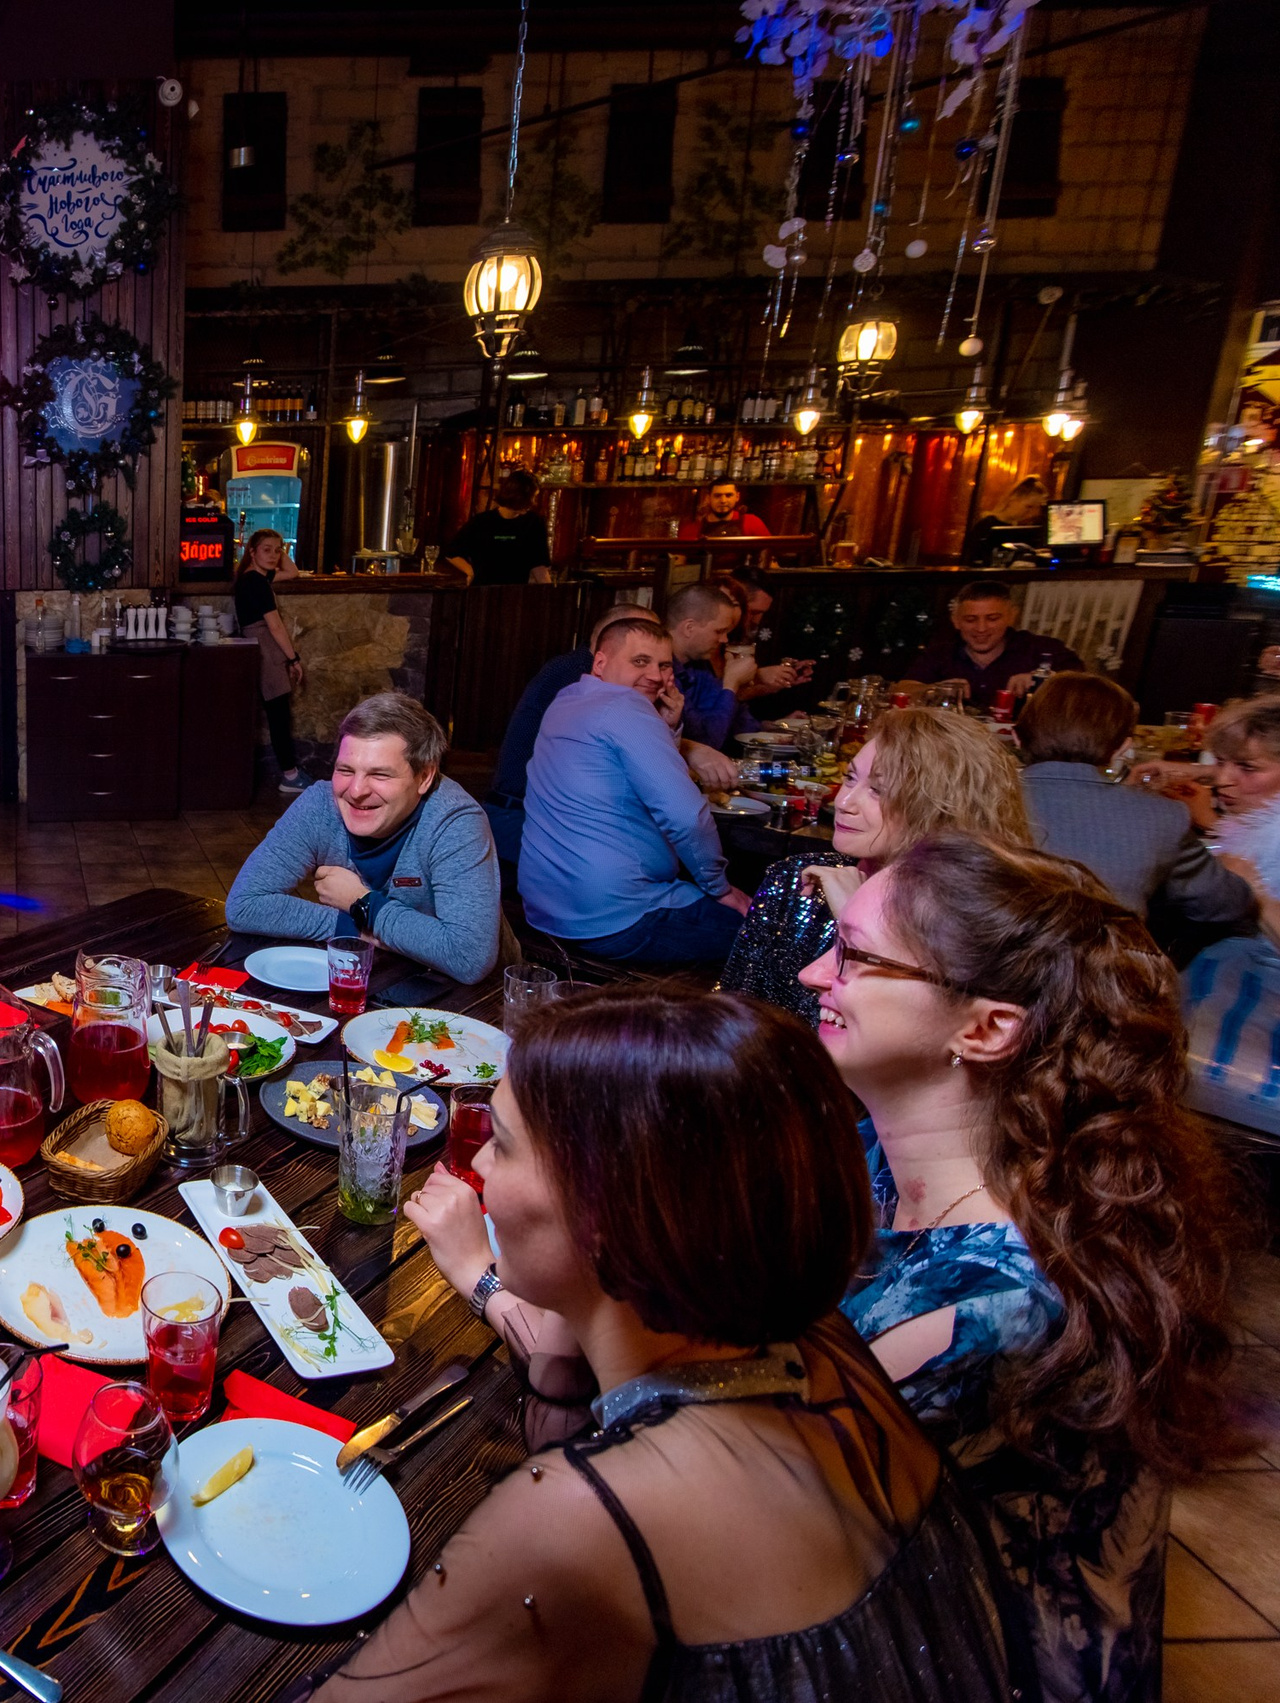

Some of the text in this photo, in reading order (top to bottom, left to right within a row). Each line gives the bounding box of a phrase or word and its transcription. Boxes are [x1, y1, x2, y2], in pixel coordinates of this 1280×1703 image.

[27, 158, 124, 195] Счастливого
[47, 189, 101, 219] Нового
[180, 541, 223, 562] Jäger
